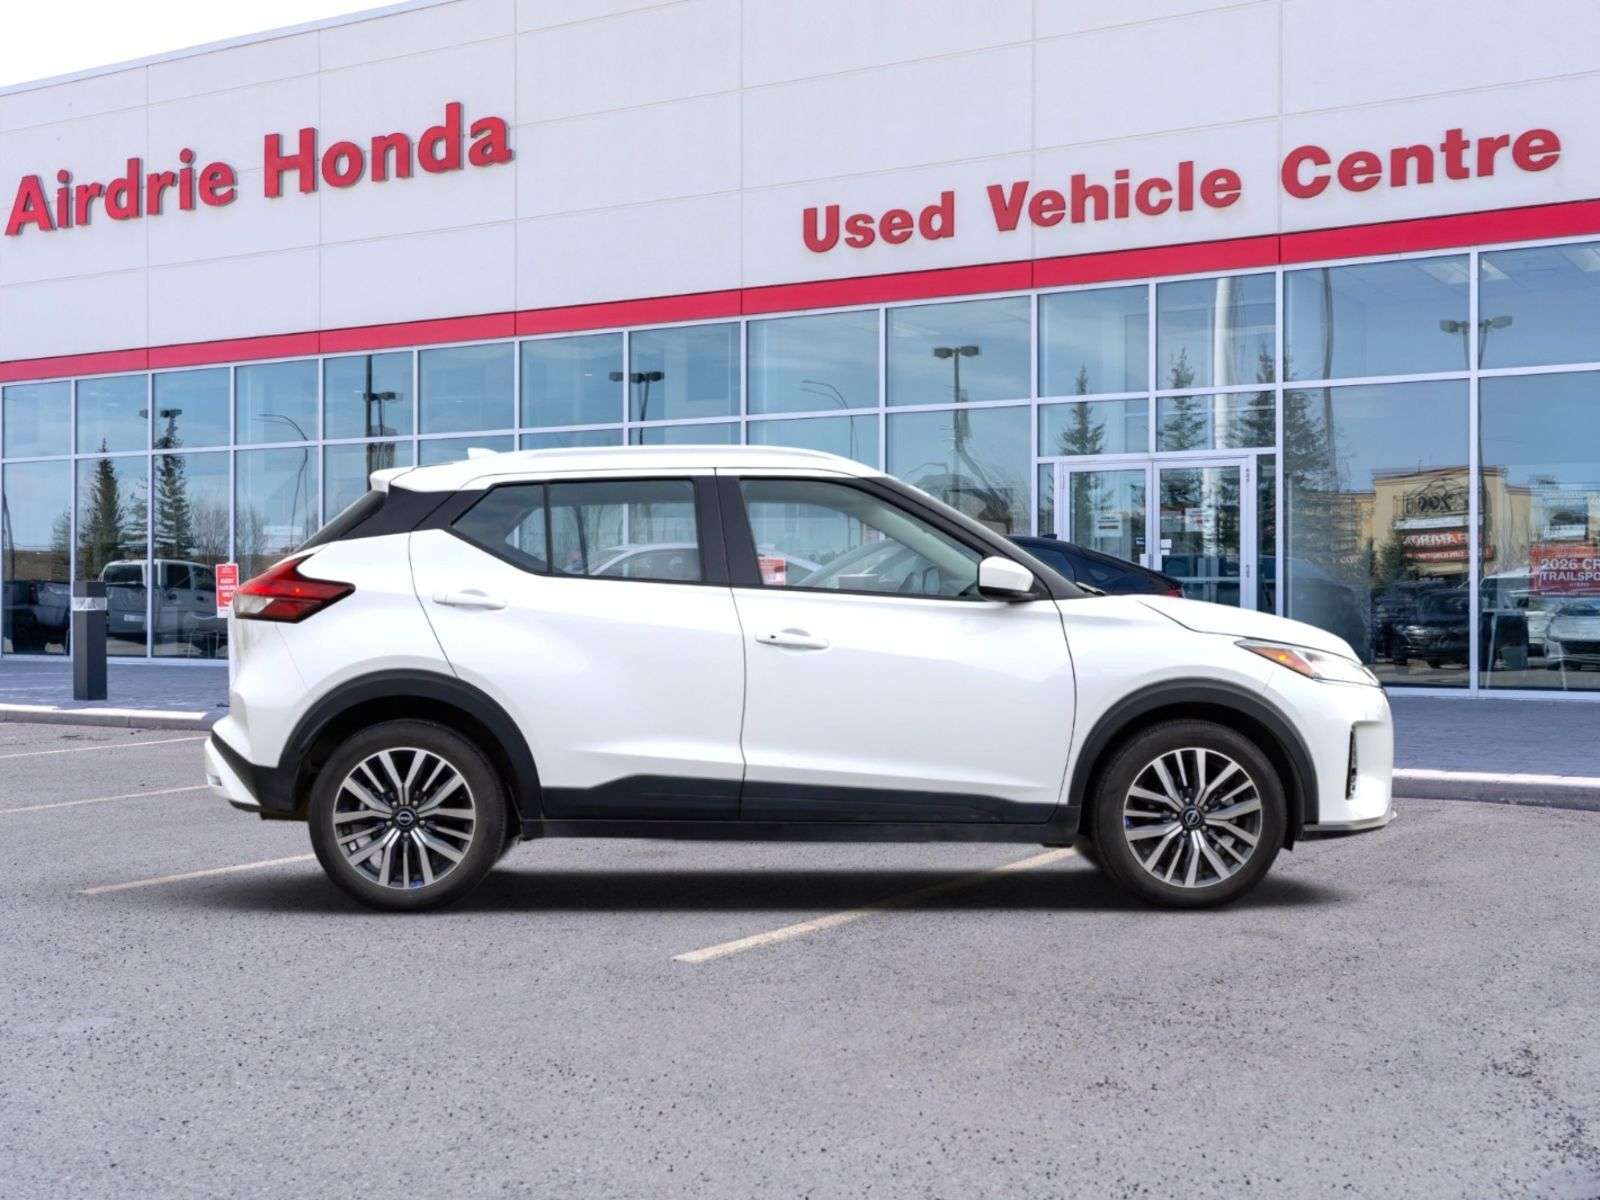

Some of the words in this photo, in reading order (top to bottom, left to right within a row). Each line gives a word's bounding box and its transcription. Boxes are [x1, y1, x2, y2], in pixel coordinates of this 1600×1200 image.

[5, 147, 236, 236] Airdrie
[264, 101, 513, 198] Honda
[803, 191, 955, 253] Used
[987, 161, 1242, 232] Vehicle
[1281, 128, 1561, 199] Centre
[1541, 558, 1578, 570] 2026
